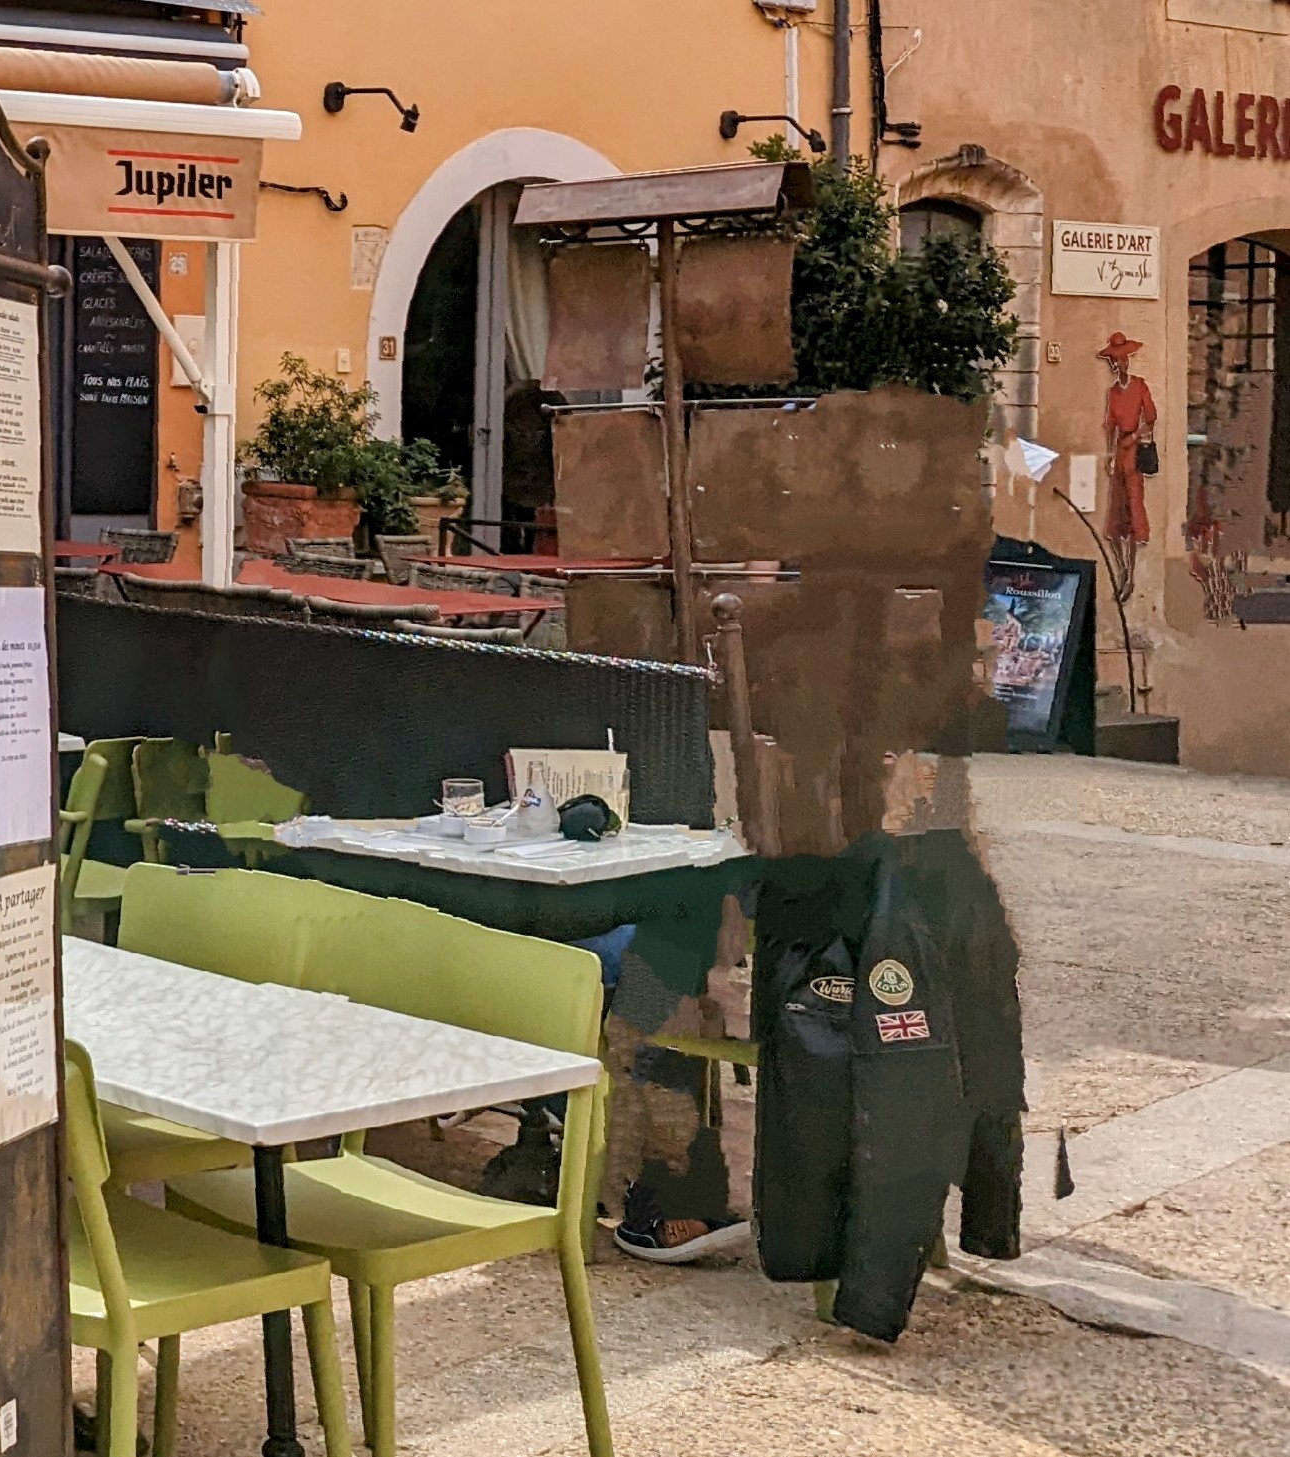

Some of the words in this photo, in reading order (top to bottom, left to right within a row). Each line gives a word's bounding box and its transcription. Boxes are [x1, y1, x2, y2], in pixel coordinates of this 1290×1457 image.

[114, 160, 233, 205] Jupiler
[1061, 229, 1114, 251] GALERIE
[1116, 234, 1153, 253] D'ART
[382, 341, 395, 354] 31
[83, 373, 103, 387] TOUS
[1005, 585, 1061, 600] Roussillon
[3, 886, 47, 917] partager
[876, 981, 908, 993] LOTUS
